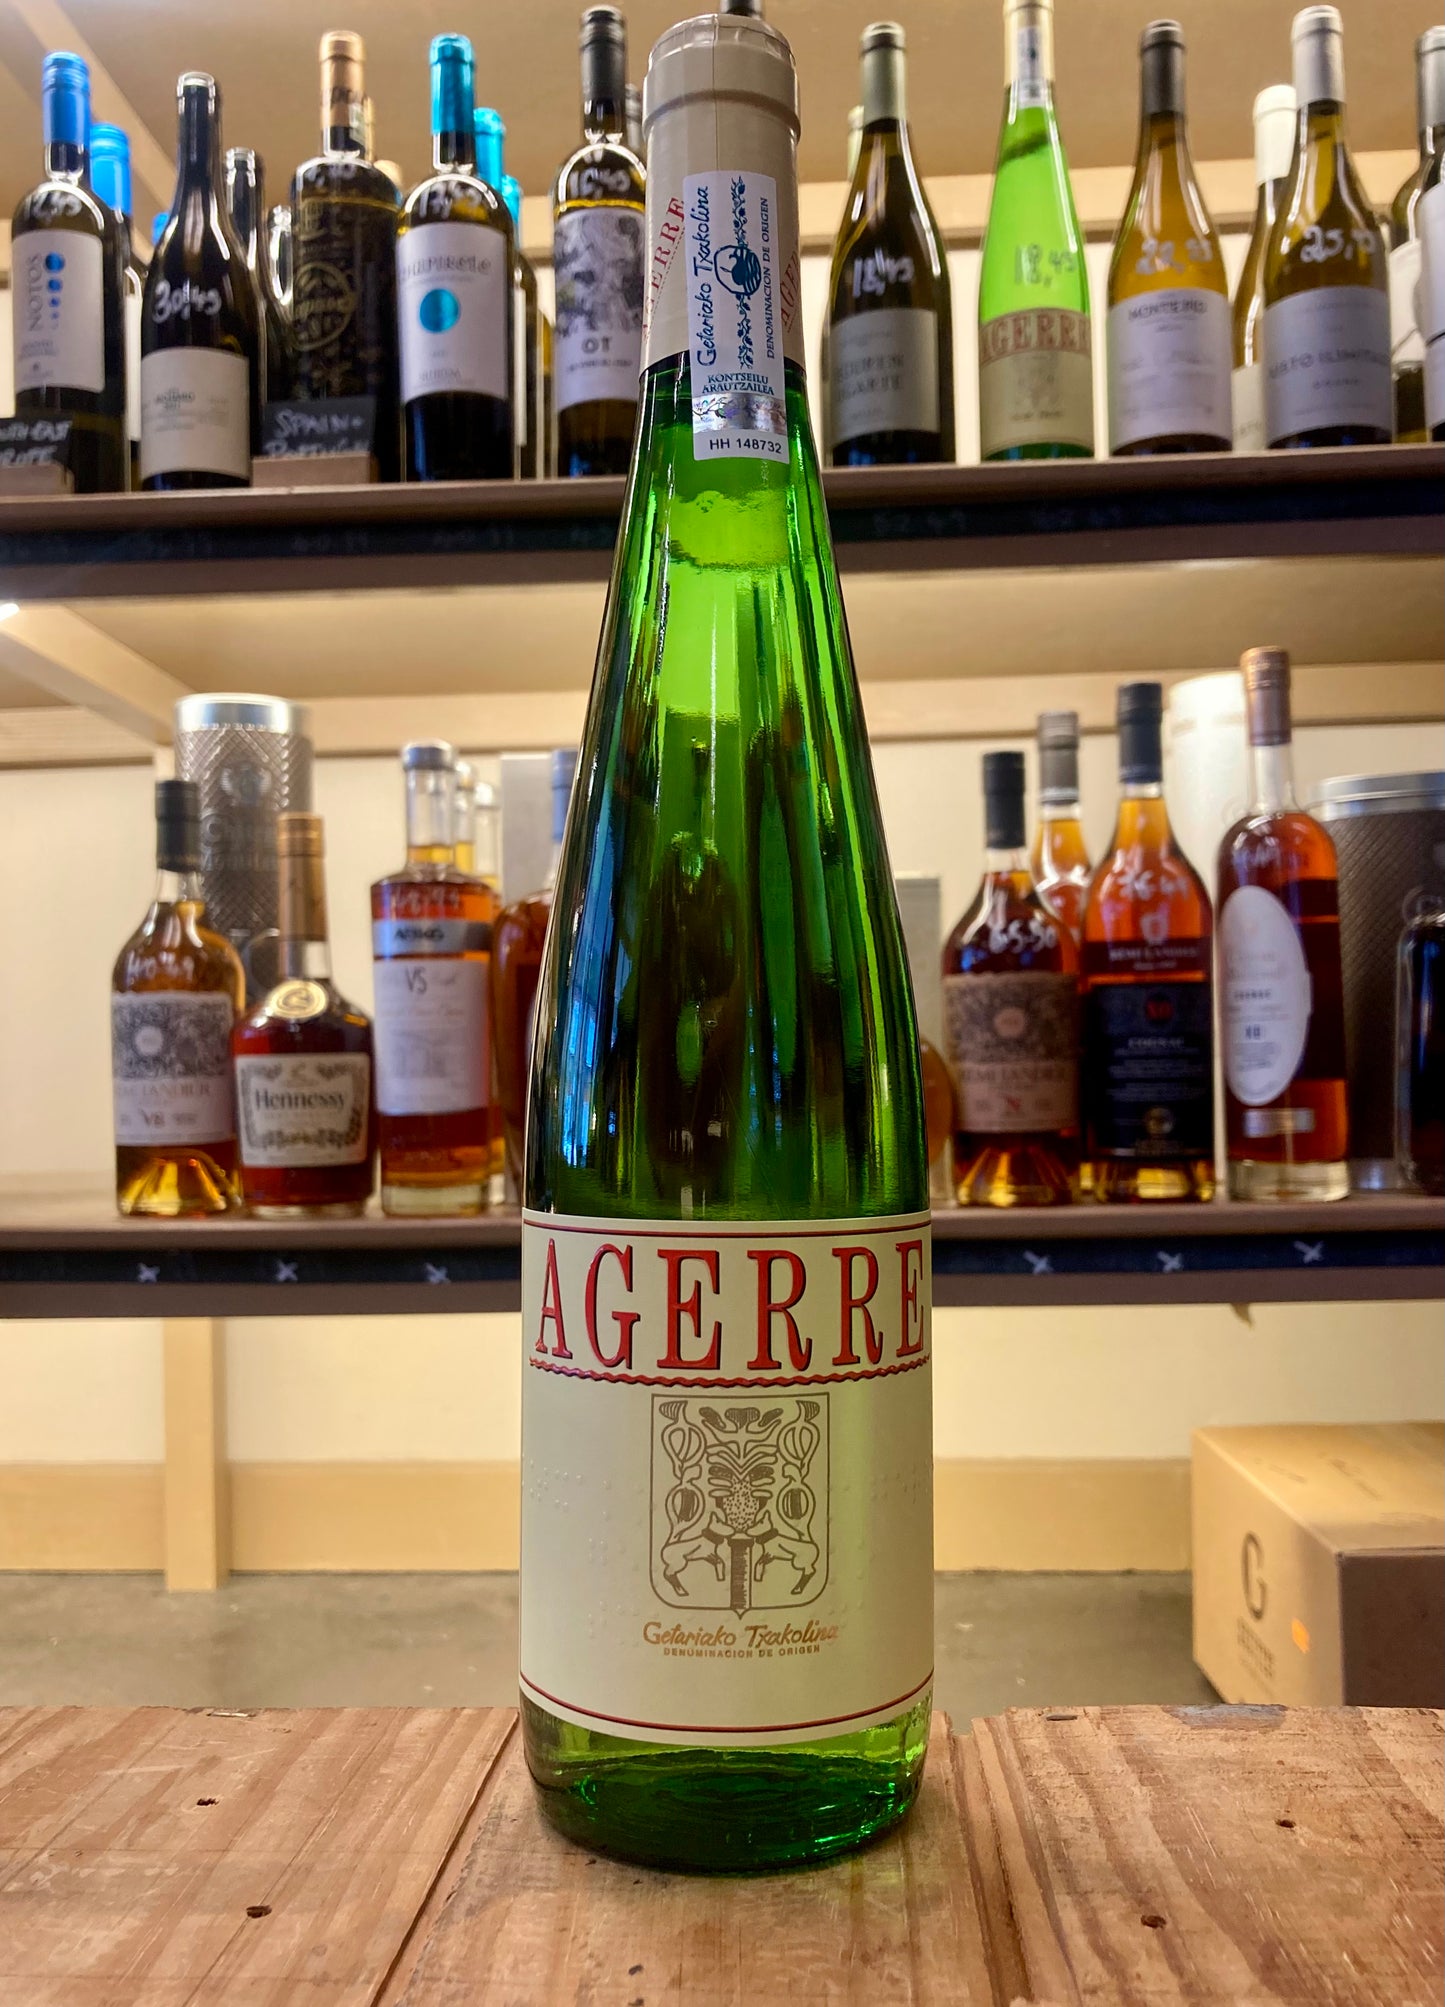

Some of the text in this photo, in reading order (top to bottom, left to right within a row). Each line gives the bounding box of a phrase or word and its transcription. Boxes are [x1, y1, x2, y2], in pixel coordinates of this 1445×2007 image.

[690, 185, 717, 366] Getariako Txakolina
[760, 197, 775, 359] DENOMINACION DE ORIGEN
[27, 254, 43, 331] NOTOS
[702, 382, 774, 395] ARAUTZAILEA
[708, 372, 769, 384] KONTSEILU
[709, 438, 782, 454] HH 148732
[255, 1088, 345, 1111] Hennessy
[535, 1238, 925, 1372] AGERRE
[643, 1620, 839, 1649] Getariako Txakolina
[758, 1648, 774, 1658] DE
[779, 1644, 821, 1657] ORIGEN
